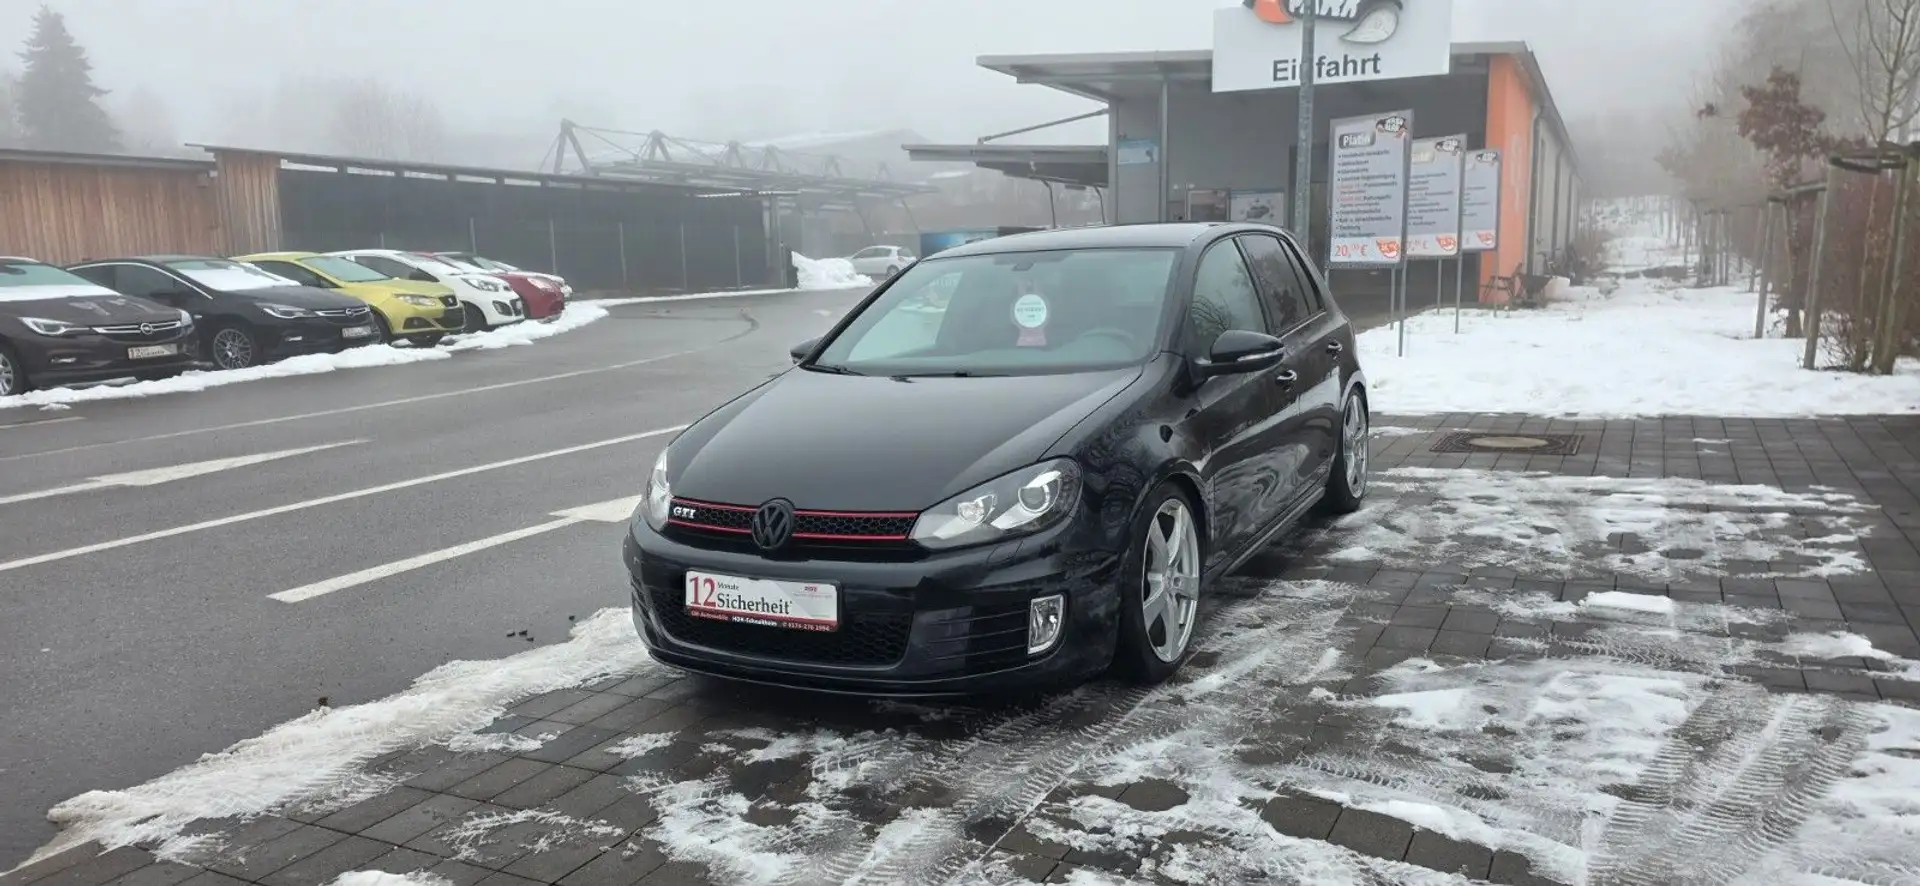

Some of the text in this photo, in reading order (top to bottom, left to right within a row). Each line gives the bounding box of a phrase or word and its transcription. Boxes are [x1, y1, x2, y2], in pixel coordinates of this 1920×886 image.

[1273, 52, 1382, 82] Eifahrt
[673, 505, 697, 519] GTI
[689, 576, 717, 608] 12
